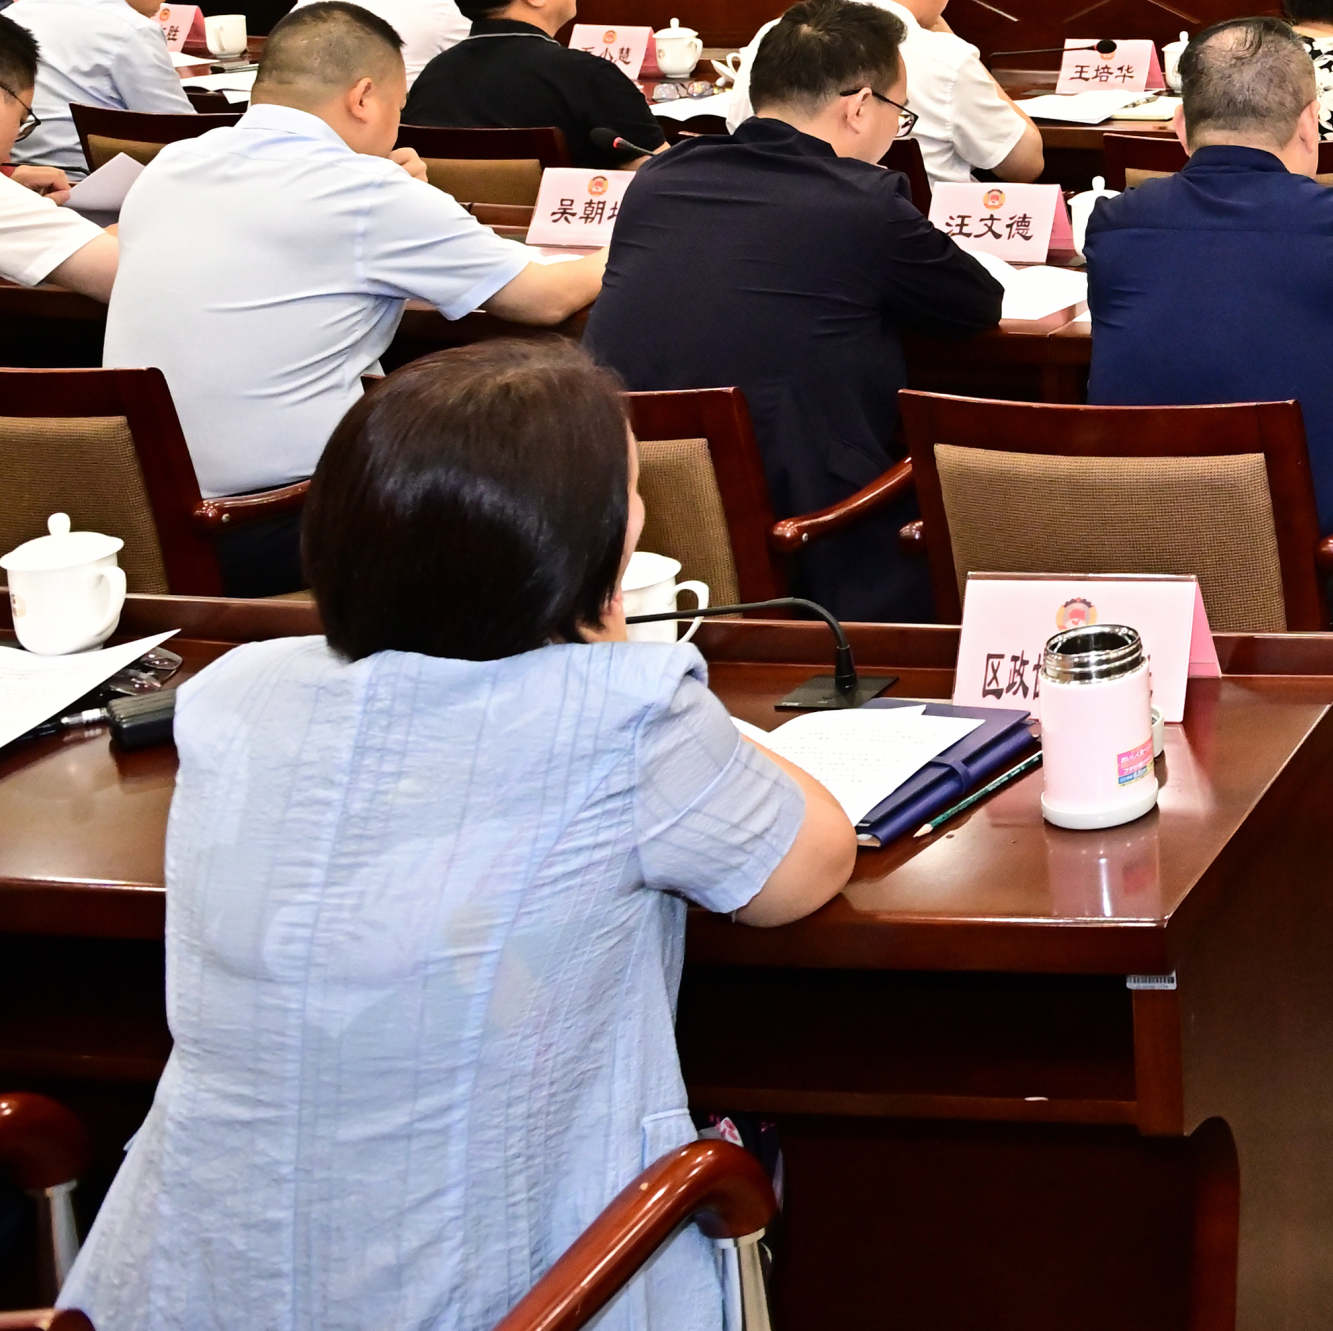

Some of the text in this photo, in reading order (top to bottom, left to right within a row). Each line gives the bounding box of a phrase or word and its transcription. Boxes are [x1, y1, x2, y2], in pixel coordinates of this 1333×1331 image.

[1068, 63, 1135, 84] 王培华
[944, 213, 1034, 241] 汪文德
